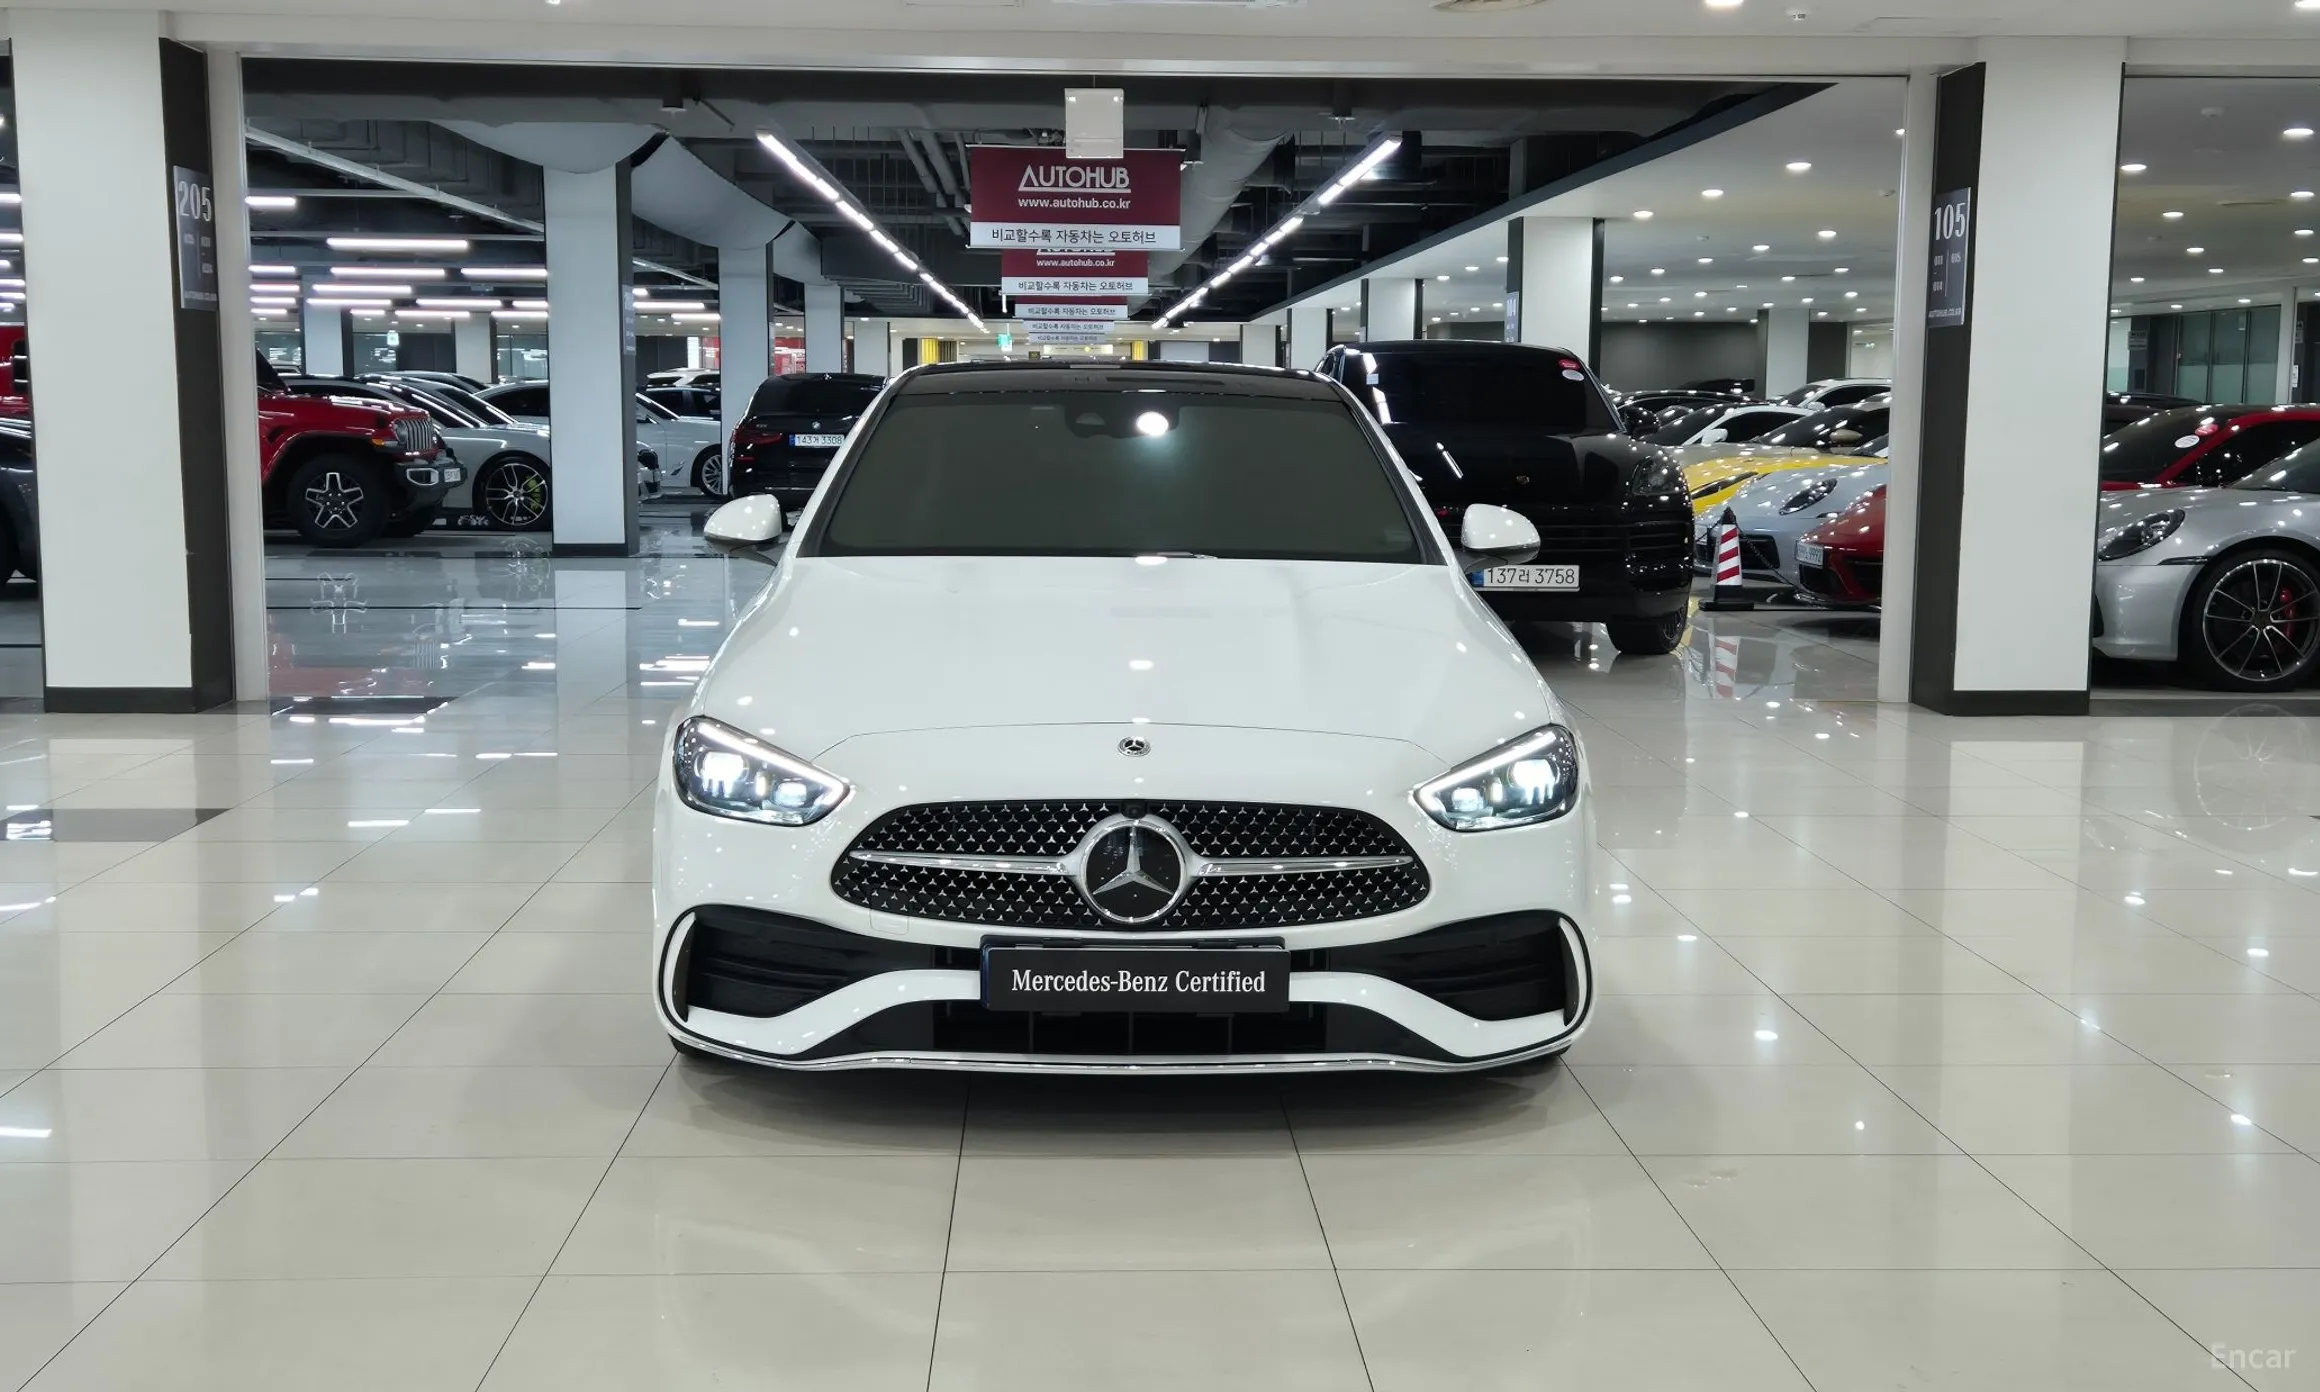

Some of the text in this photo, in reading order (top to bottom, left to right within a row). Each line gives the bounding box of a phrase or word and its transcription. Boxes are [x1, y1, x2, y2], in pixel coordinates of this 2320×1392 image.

[1018, 165, 1131, 193] AUTOHUB
[179, 181, 212, 221] 205
[1018, 197, 1131, 209] www.autohub.co.kr
[1934, 202, 1966, 240] 105
[992, 229, 1156, 244] 비교할수록 자동차는 오토허브
[1036, 258, 1115, 266] www.autohub.co.kr
[1018, 281, 1133, 291] 비교할수록 자동차는 오토허브
[1487, 568, 1575, 584] 137러 3758
[1011, 969, 1266, 993] Mercedes-Benz Certified
